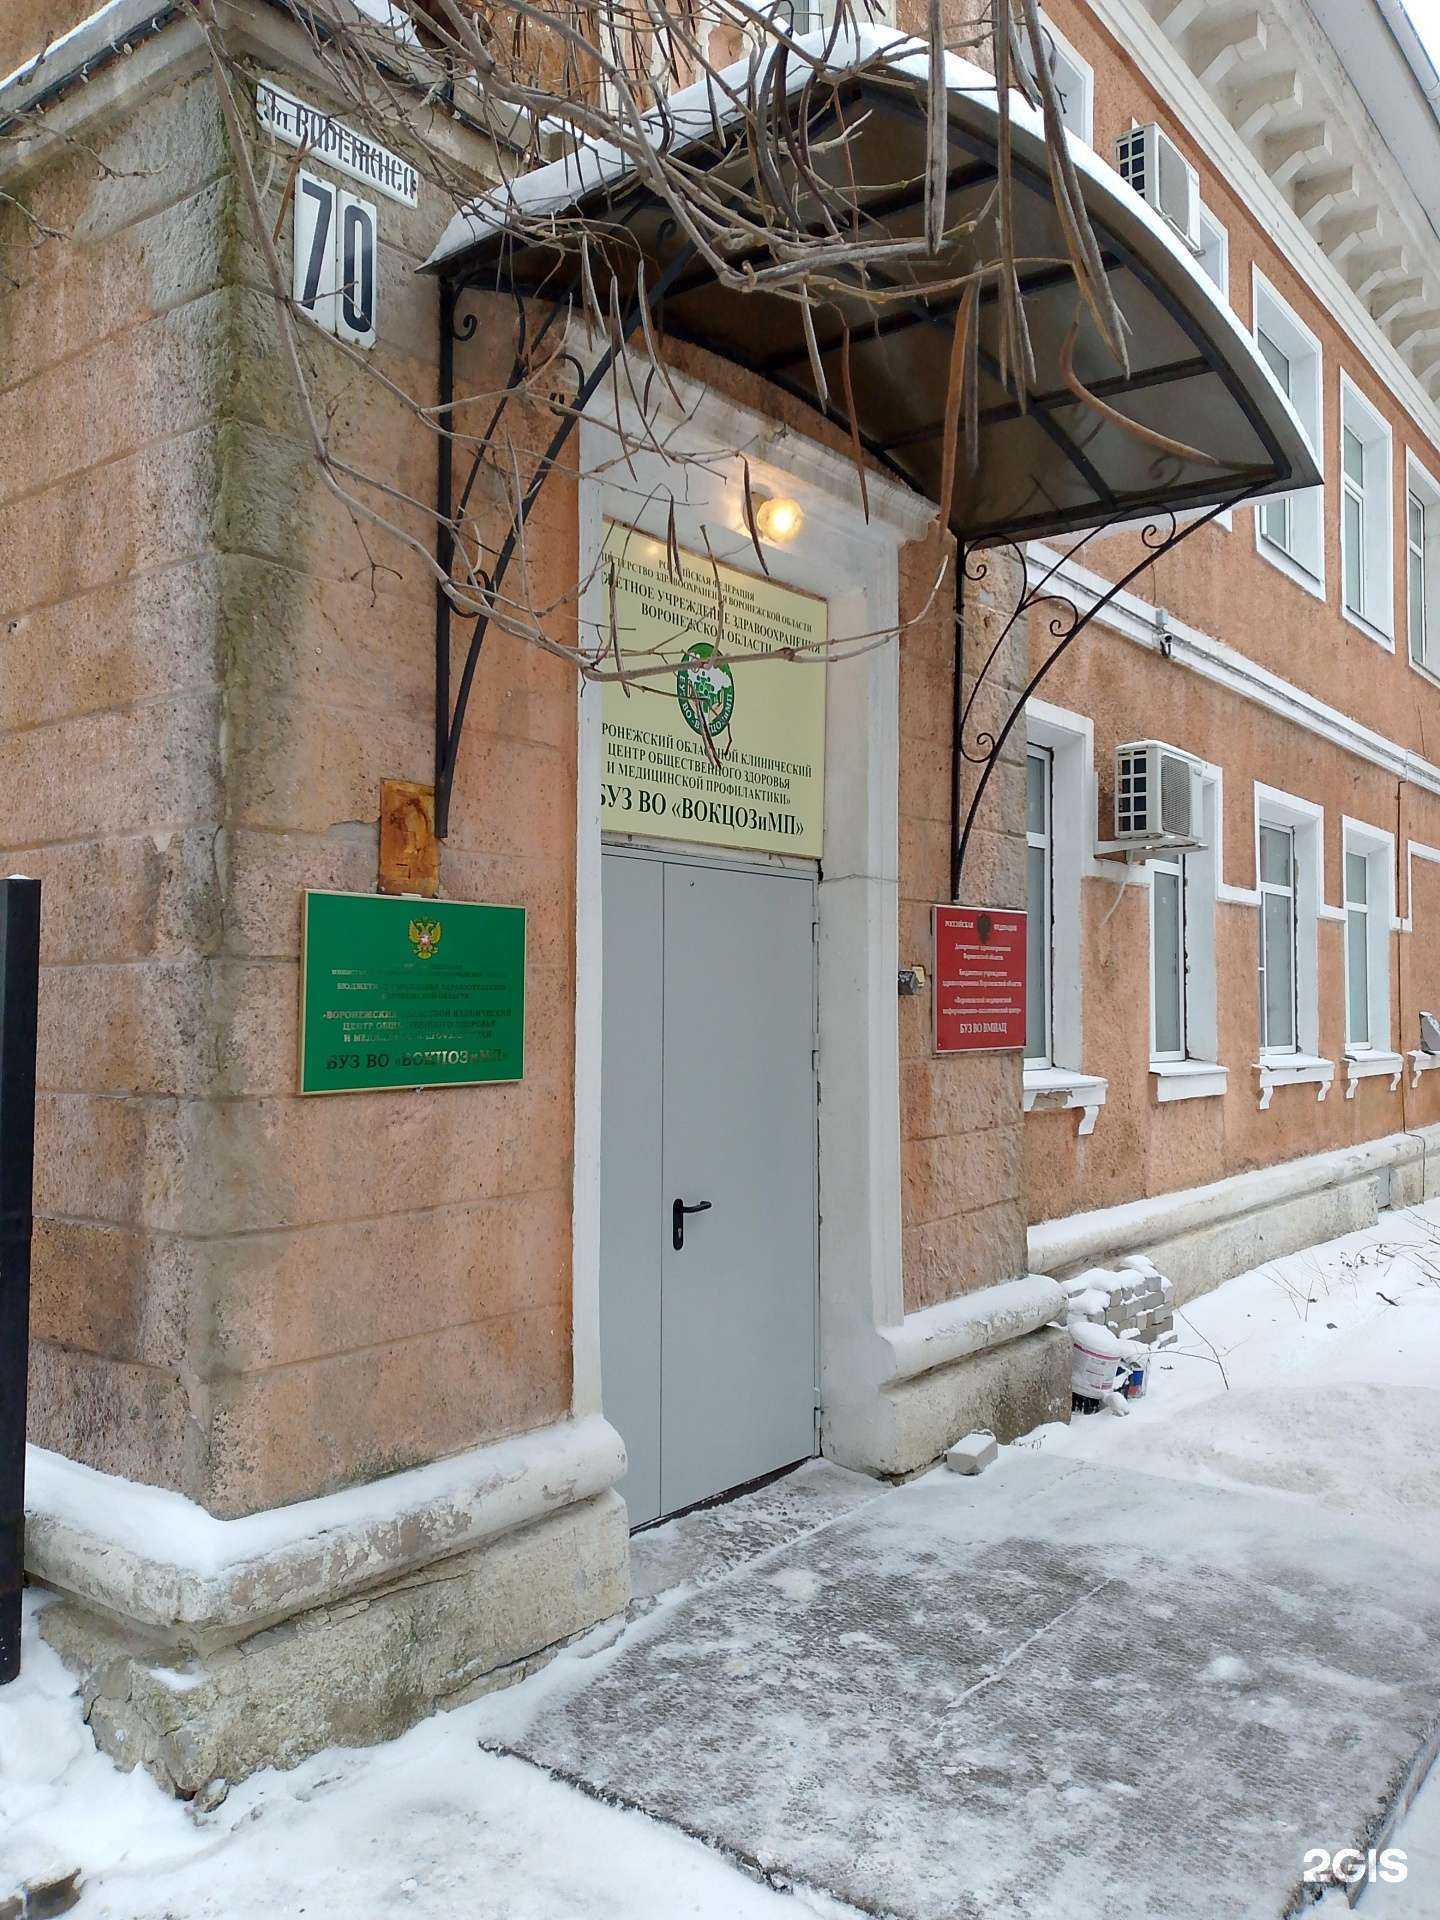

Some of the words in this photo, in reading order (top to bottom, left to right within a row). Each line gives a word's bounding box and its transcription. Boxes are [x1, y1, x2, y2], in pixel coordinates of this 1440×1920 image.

[303, 177, 372, 333] 70
[727, 631, 772, 654] ОБЛАСТИ
[607, 760, 615, 774] И
[618, 763, 704, 791] МЕДИЦИНСКОЙ
[706, 780, 791, 806] ПРОФИЛАКТИКИ»
[608, 742, 646, 762] ЦЕНТР
[744, 770, 790, 790] ЗДОРОВЬЯ
[741, 752, 812, 778] КЛИНИЧЕСКИЙ
[638, 790, 667, 816] ВО
[671, 797, 804, 836] «ВОКЦОЗиМП»
[366, 1053, 389, 1068] ВО
